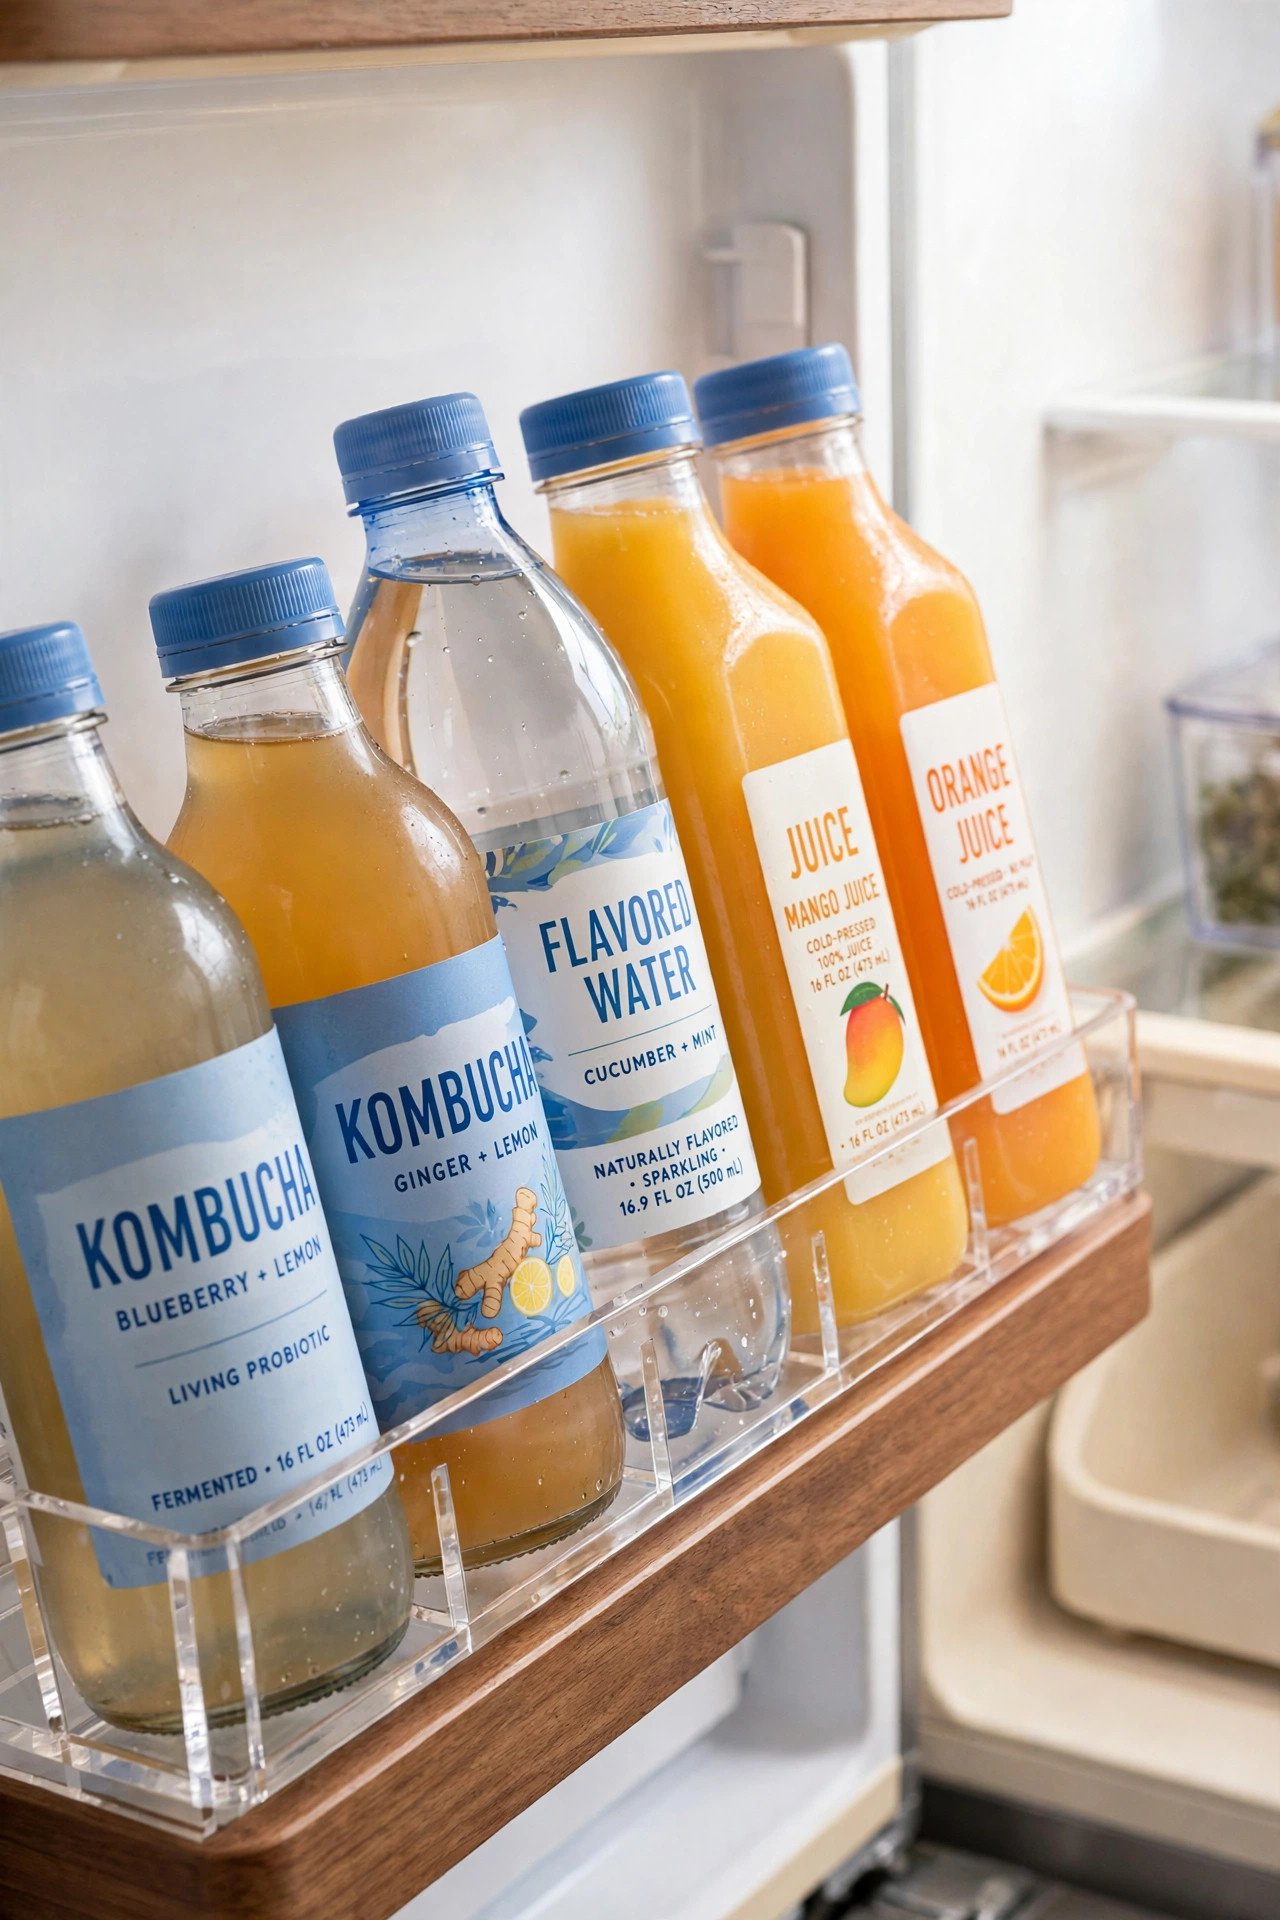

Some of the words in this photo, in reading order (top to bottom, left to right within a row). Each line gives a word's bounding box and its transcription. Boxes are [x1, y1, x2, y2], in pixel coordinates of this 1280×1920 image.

[926, 743, 1011, 813] ORANGE
[786, 806, 859, 880] JUICE
[957, 803, 1014, 864] JUICE
[538, 879, 692, 973] FLAVORED
[783, 889, 840, 932] MANGO
[843, 873, 880, 910] JUICE
[806, 917, 876, 954] COLD-PRESSED
[583, 945, 697, 1024] WATER
[810, 978, 822, 993] 16
[824, 973, 836, 988] FL
[838, 966, 851, 982] OZ
[817, 950, 844, 970] 100%
[847, 936, 872, 959] JUICE
[584, 1043, 677, 1085] CUCUMBER
[681, 1042, 689, 1052] +
[692, 1025, 717, 1050] MINT
[335, 1036, 538, 1164] KOMBUCHA
[394, 1154, 472, 1193] GINGER
[478, 1152, 487, 1162] +
[494, 1120, 539, 1160] LEMON
[593, 1140, 681, 1179] NATURALLY
[686, 1114, 739, 1151] FLAVORED
[642, 1147, 718, 1188] SPARKLING
[76, 1144, 316, 1289] KOMBUCHA
[619, 1195, 648, 1216] 16.9
[654, 1188, 672, 1207] FL
[675, 1180, 695, 1199] OZ
[697, 1167, 724, 1194] (500
[726, 1156, 744, 1178] mL)
[116, 1271, 248, 1331] BLUEBERRY
[258, 1269, 267, 1281] +
[273, 1234, 322, 1278] LEMON
[168, 1368, 240, 1405] LIVING
[246, 1324, 331, 1380] PROBIOTIC
[151, 1466, 257, 1511] FERMENTED
[276, 1451, 294, 1472] 16
[297, 1443, 315, 1464] FL
[316, 1430, 333, 1453] OZ
[335, 1416, 355, 1445] (473
[356, 1401, 369, 1427] mL)
